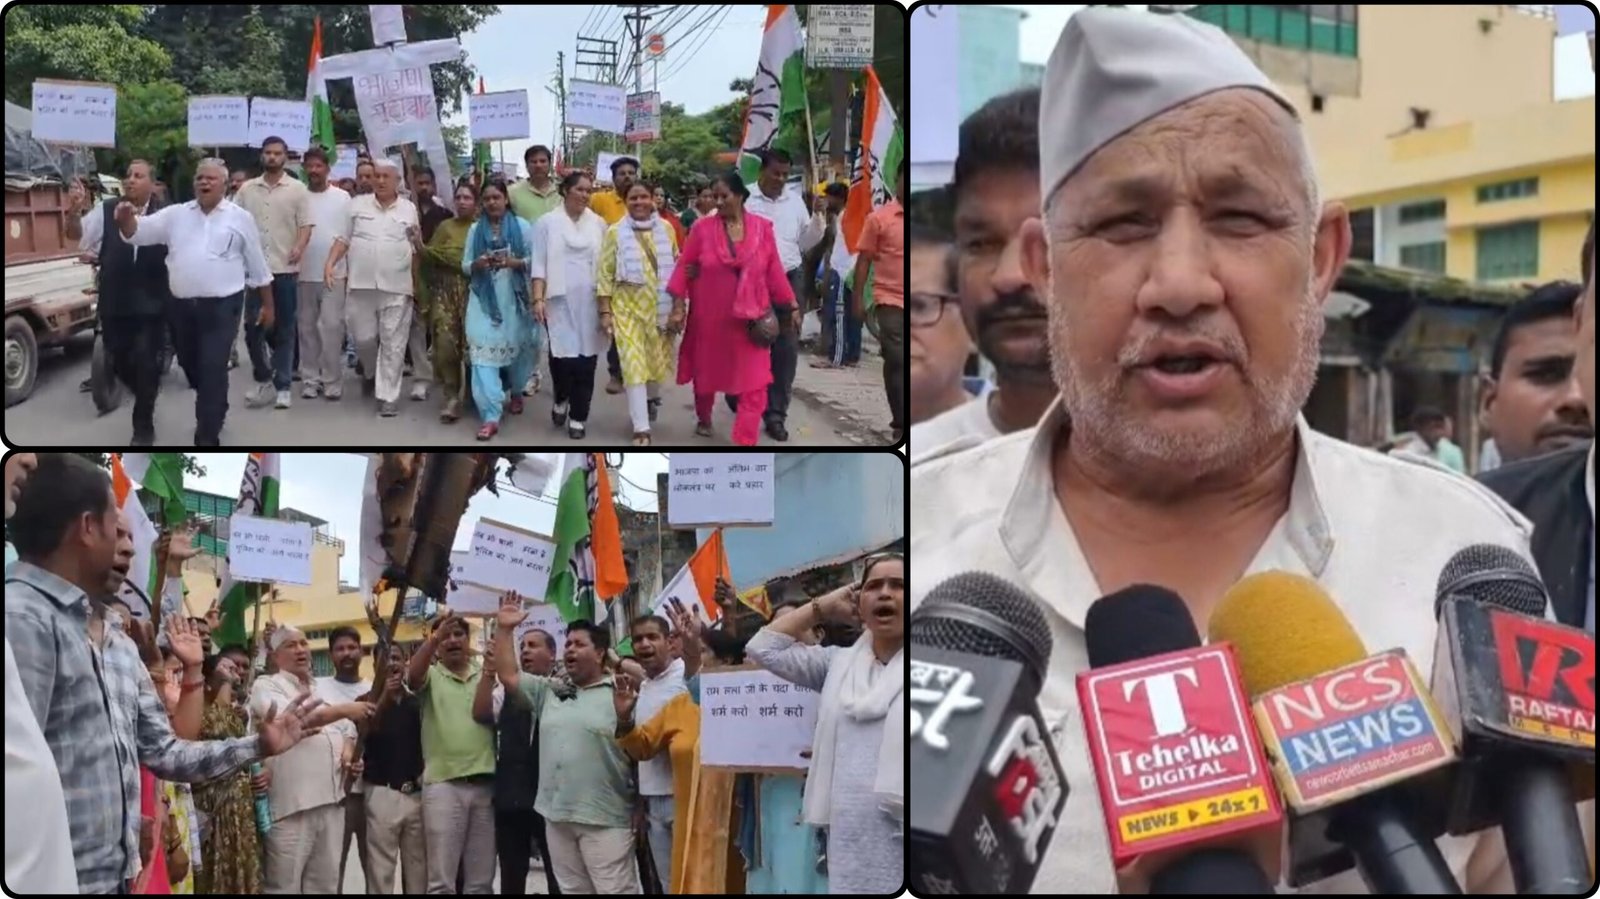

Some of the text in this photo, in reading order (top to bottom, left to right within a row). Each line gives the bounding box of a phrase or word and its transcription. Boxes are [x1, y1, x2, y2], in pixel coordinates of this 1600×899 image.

[711, 702, 804, 718] शर्म करो शर्म करो
[1122, 667, 1199, 739] T
[1272, 660, 1403, 730] NCS
[1509, 695, 1595, 731] RAFTA
[1114, 734, 1239, 776] Tehelka
[1291, 704, 1424, 771] NEWS
[1139, 760, 1227, 790] DIGITAL
[1126, 811, 1179, 835] NEWS
